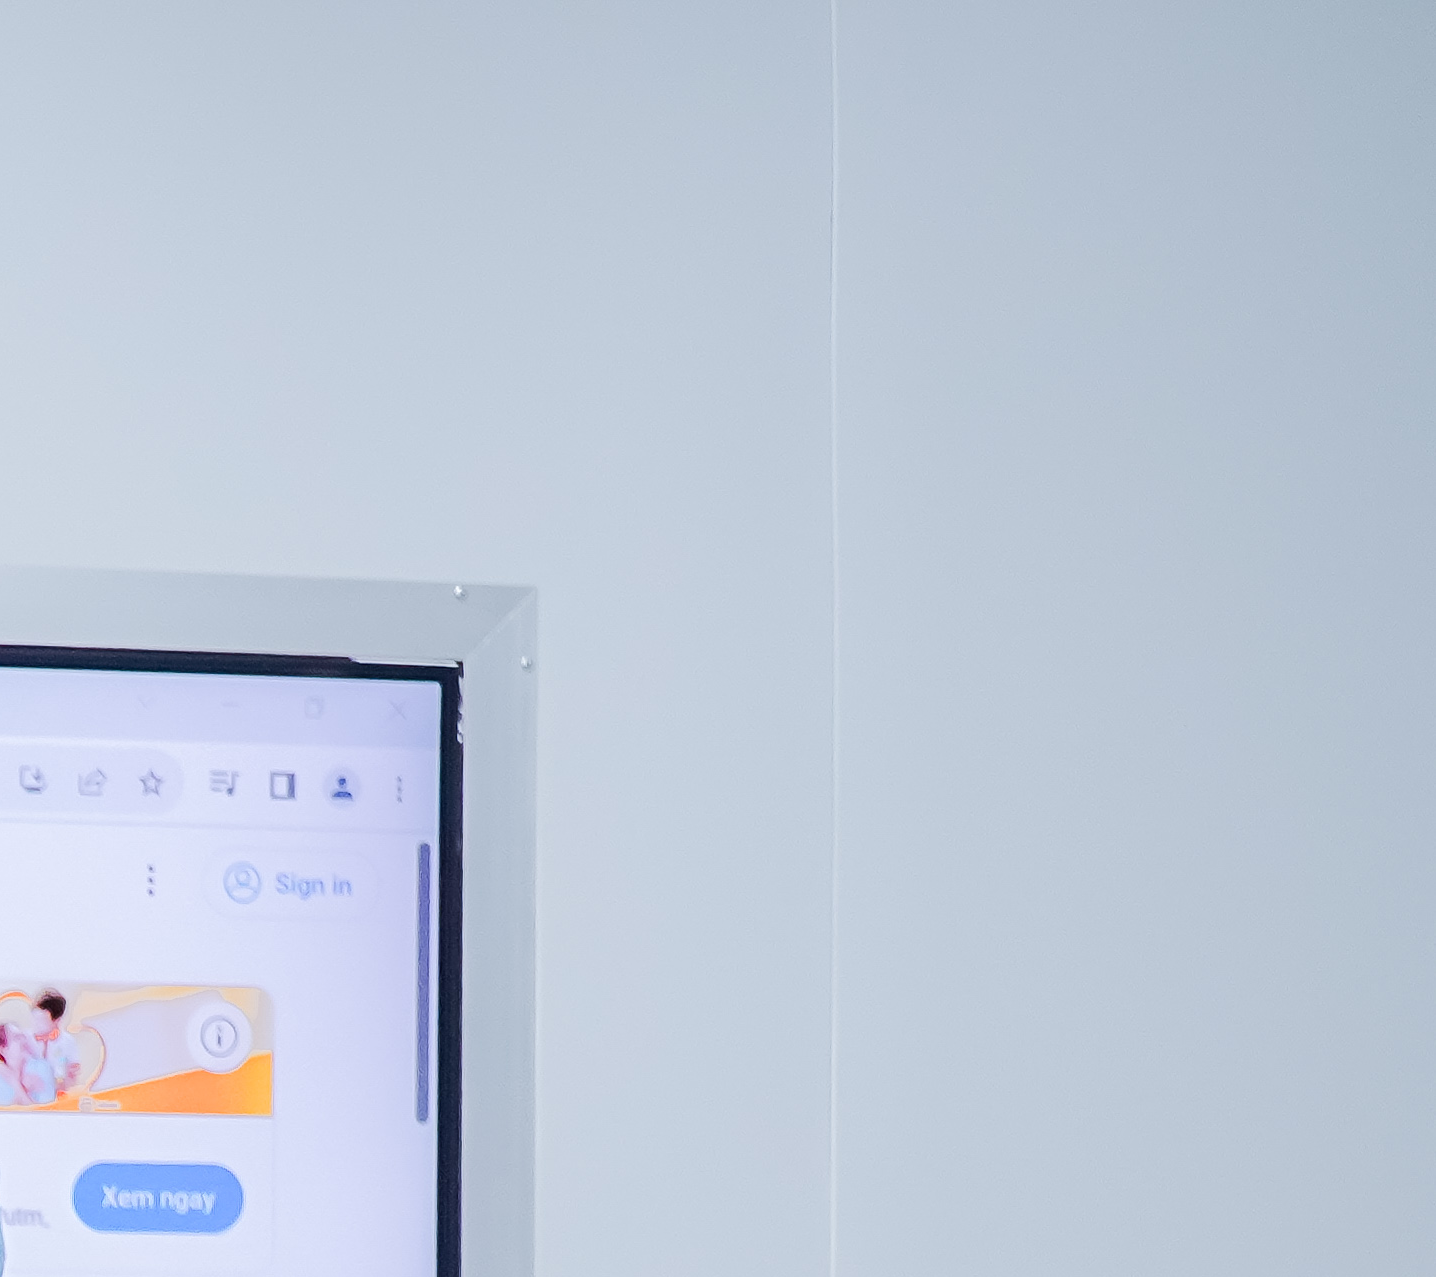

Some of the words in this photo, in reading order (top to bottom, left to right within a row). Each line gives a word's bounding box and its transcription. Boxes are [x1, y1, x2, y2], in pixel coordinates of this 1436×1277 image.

[275, 873, 325, 900] Sign
[332, 875, 353, 897] in
[101, 1184, 154, 1210] Xem
[159, 1191, 216, 1215] ngay
